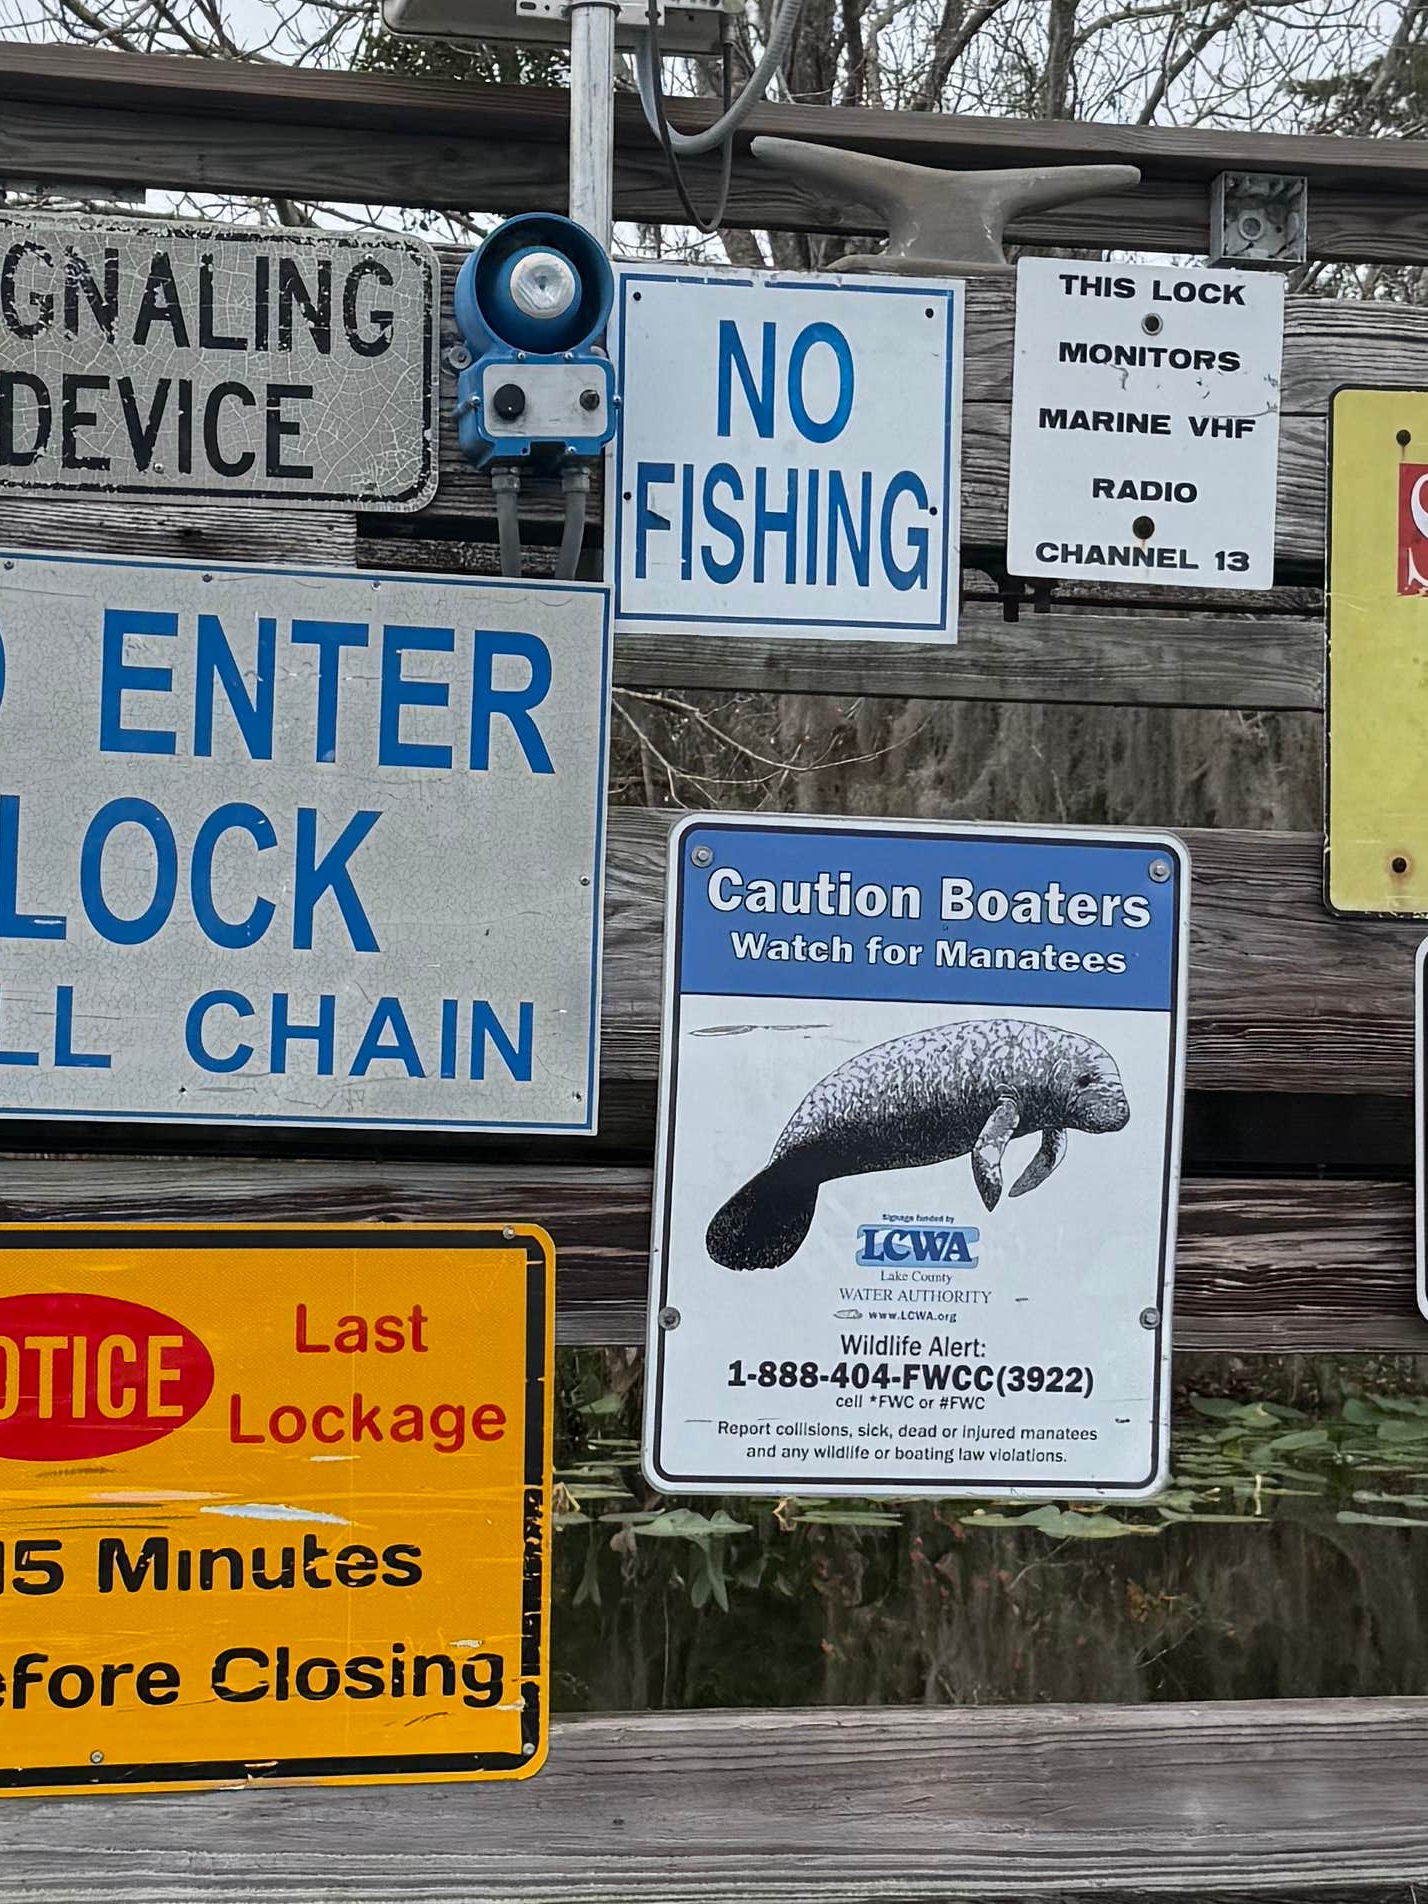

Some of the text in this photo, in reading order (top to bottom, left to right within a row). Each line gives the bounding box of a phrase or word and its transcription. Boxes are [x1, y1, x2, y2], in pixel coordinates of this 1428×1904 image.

[1059, 275, 1246, 306] THIS LOCK
[1059, 341, 1241, 372] MONITORS
[717, 320, 854, 444] NO
[1039, 409, 1256, 439] MARINE VHF
[1092, 477, 1198, 504] RADIO
[635, 462, 929, 592] FISHING
[1035, 543, 1250, 573] CHANNEL 13
[99, 608, 556, 775] ENTER
[707, 867, 1151, 928] Caution Boaters
[730, 930, 1127, 974] Watch for Manatees
[184, 988, 534, 1081] CHAIN
[916, 1214, 943, 1222] funded
[945, 1215, 954, 1224] by
[861, 1229, 972, 1262] LCWA
[880, 1271, 952, 1285] Lake County
[839, 1288, 992, 1304] WATER AUTHORITY
[295, 1303, 428, 1353] Last
[868, 1310, 957, 1322] www.LCWA.org
[841, 1334, 986, 1357] Wildlife Alert:
[728, 1360, 1094, 1399] 1-888-404-FWCC(3922)
[836, 1395, 862, 1408] cell
[919, 1398, 933, 1409] or
[940, 1396, 985, 1410] #FWC
[230, 1394, 507, 1454] Lockage
[718, 1421, 1098, 1442] Report collisions, sick, dead or injured manatees
[746, 1444, 1067, 1463] and any wildlife or boating law violations.
[97, 1533, 423, 1592] Minutes
[211, 1643, 505, 1709] Closing
